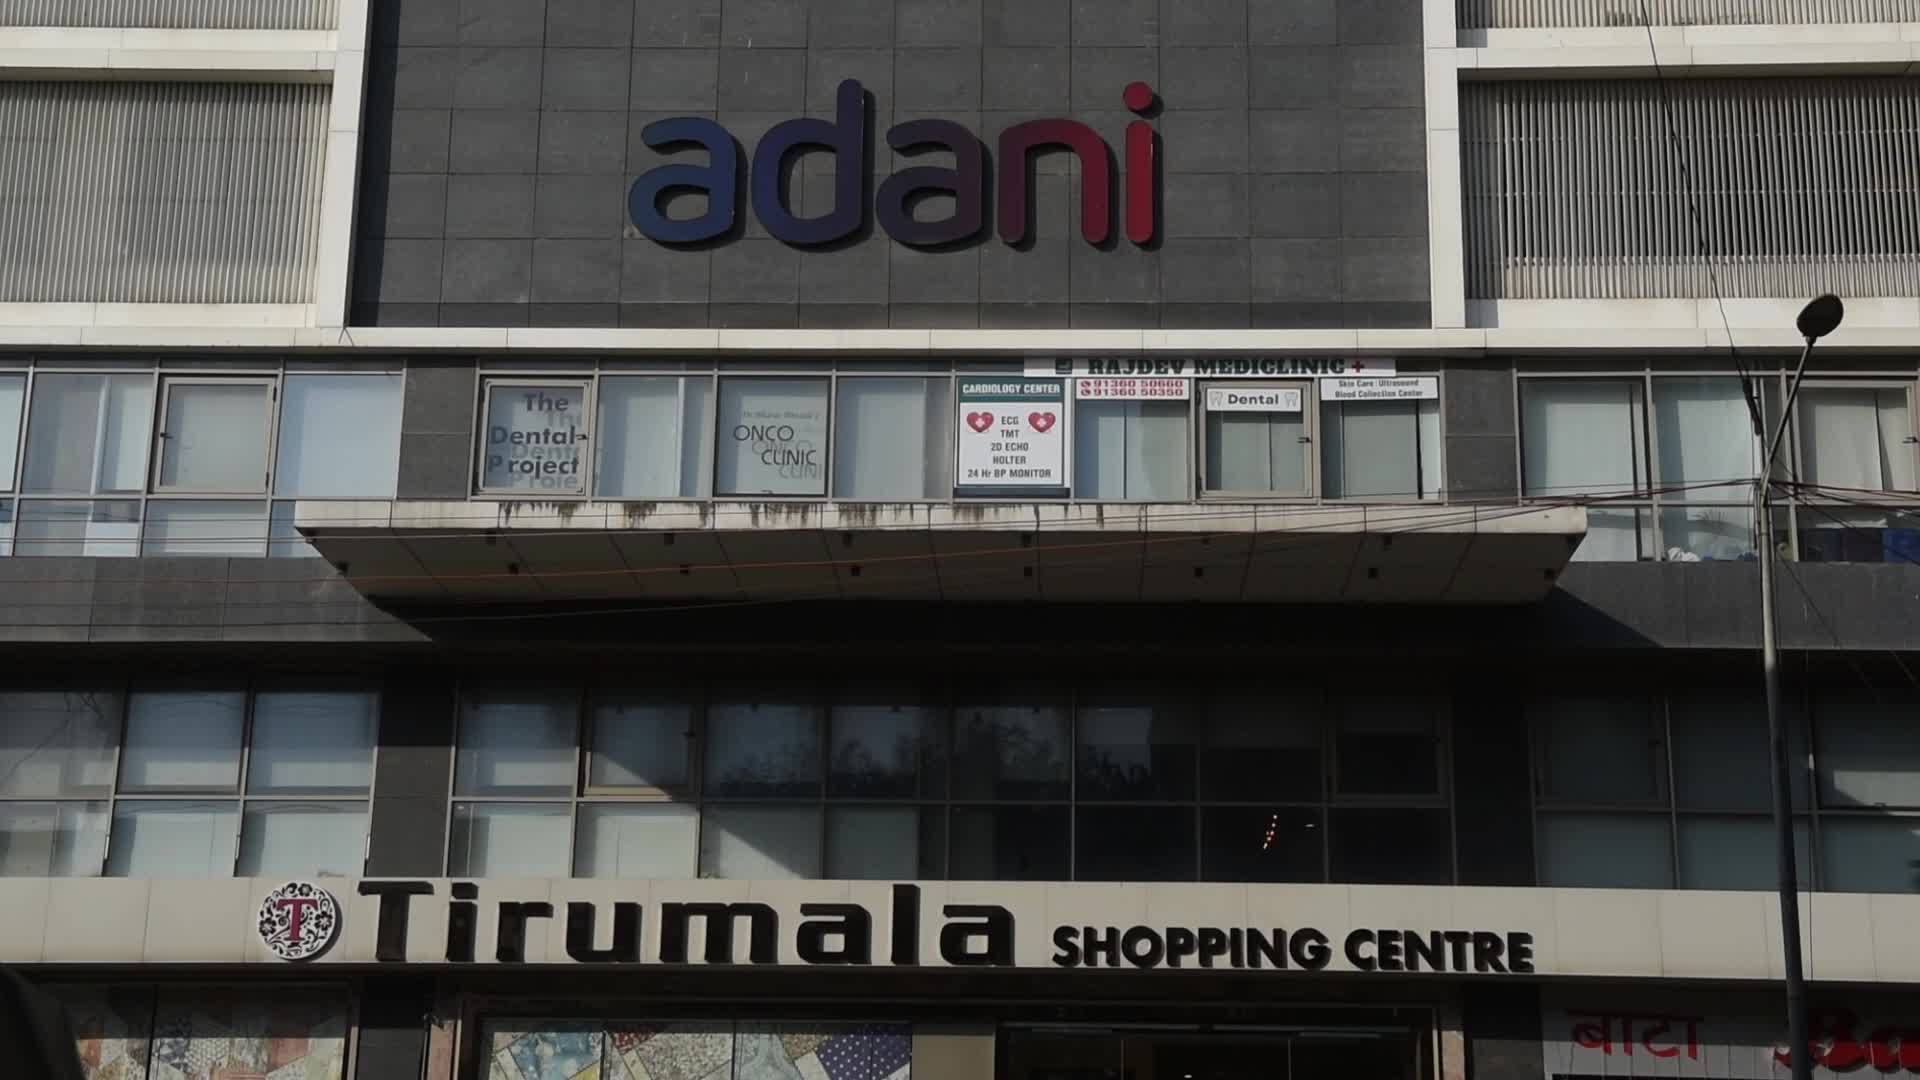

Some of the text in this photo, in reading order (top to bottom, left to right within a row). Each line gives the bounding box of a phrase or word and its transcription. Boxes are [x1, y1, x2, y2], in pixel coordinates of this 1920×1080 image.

[628, 78, 1155, 246] adani
[1087, 359, 1345, 375] RAJDEV MEDICLINIC
[962, 384, 1060, 394] CARDIOLOGY CENTER
[1339, 379, 1419, 387] Skin Care Ultrasound
[1093, 388, 1183, 396] 91360 50350
[1228, 393, 1279, 405] Dental
[1358, 390, 1396, 398] Collection
[523, 392, 569, 411] The
[1001, 416, 1019, 425] ECG
[490, 425, 576, 445] Dental
[733, 424, 794, 441] ONCO
[1001, 429, 1020, 438] TMT
[991, 442, 1029, 452] 2D ECHO
[761, 449, 817, 466] CLINIC
[993, 455, 1026, 465] HOLTER
[487, 456, 579, 480] Project
[967, 469, 1051, 478] 24 Hr BP MONITOR
[273, 898, 320, 942] T
[358, 881, 1535, 972] Tirumala SHOPPING CENTRE
[1568, 1009, 1704, 1060] बाटा
